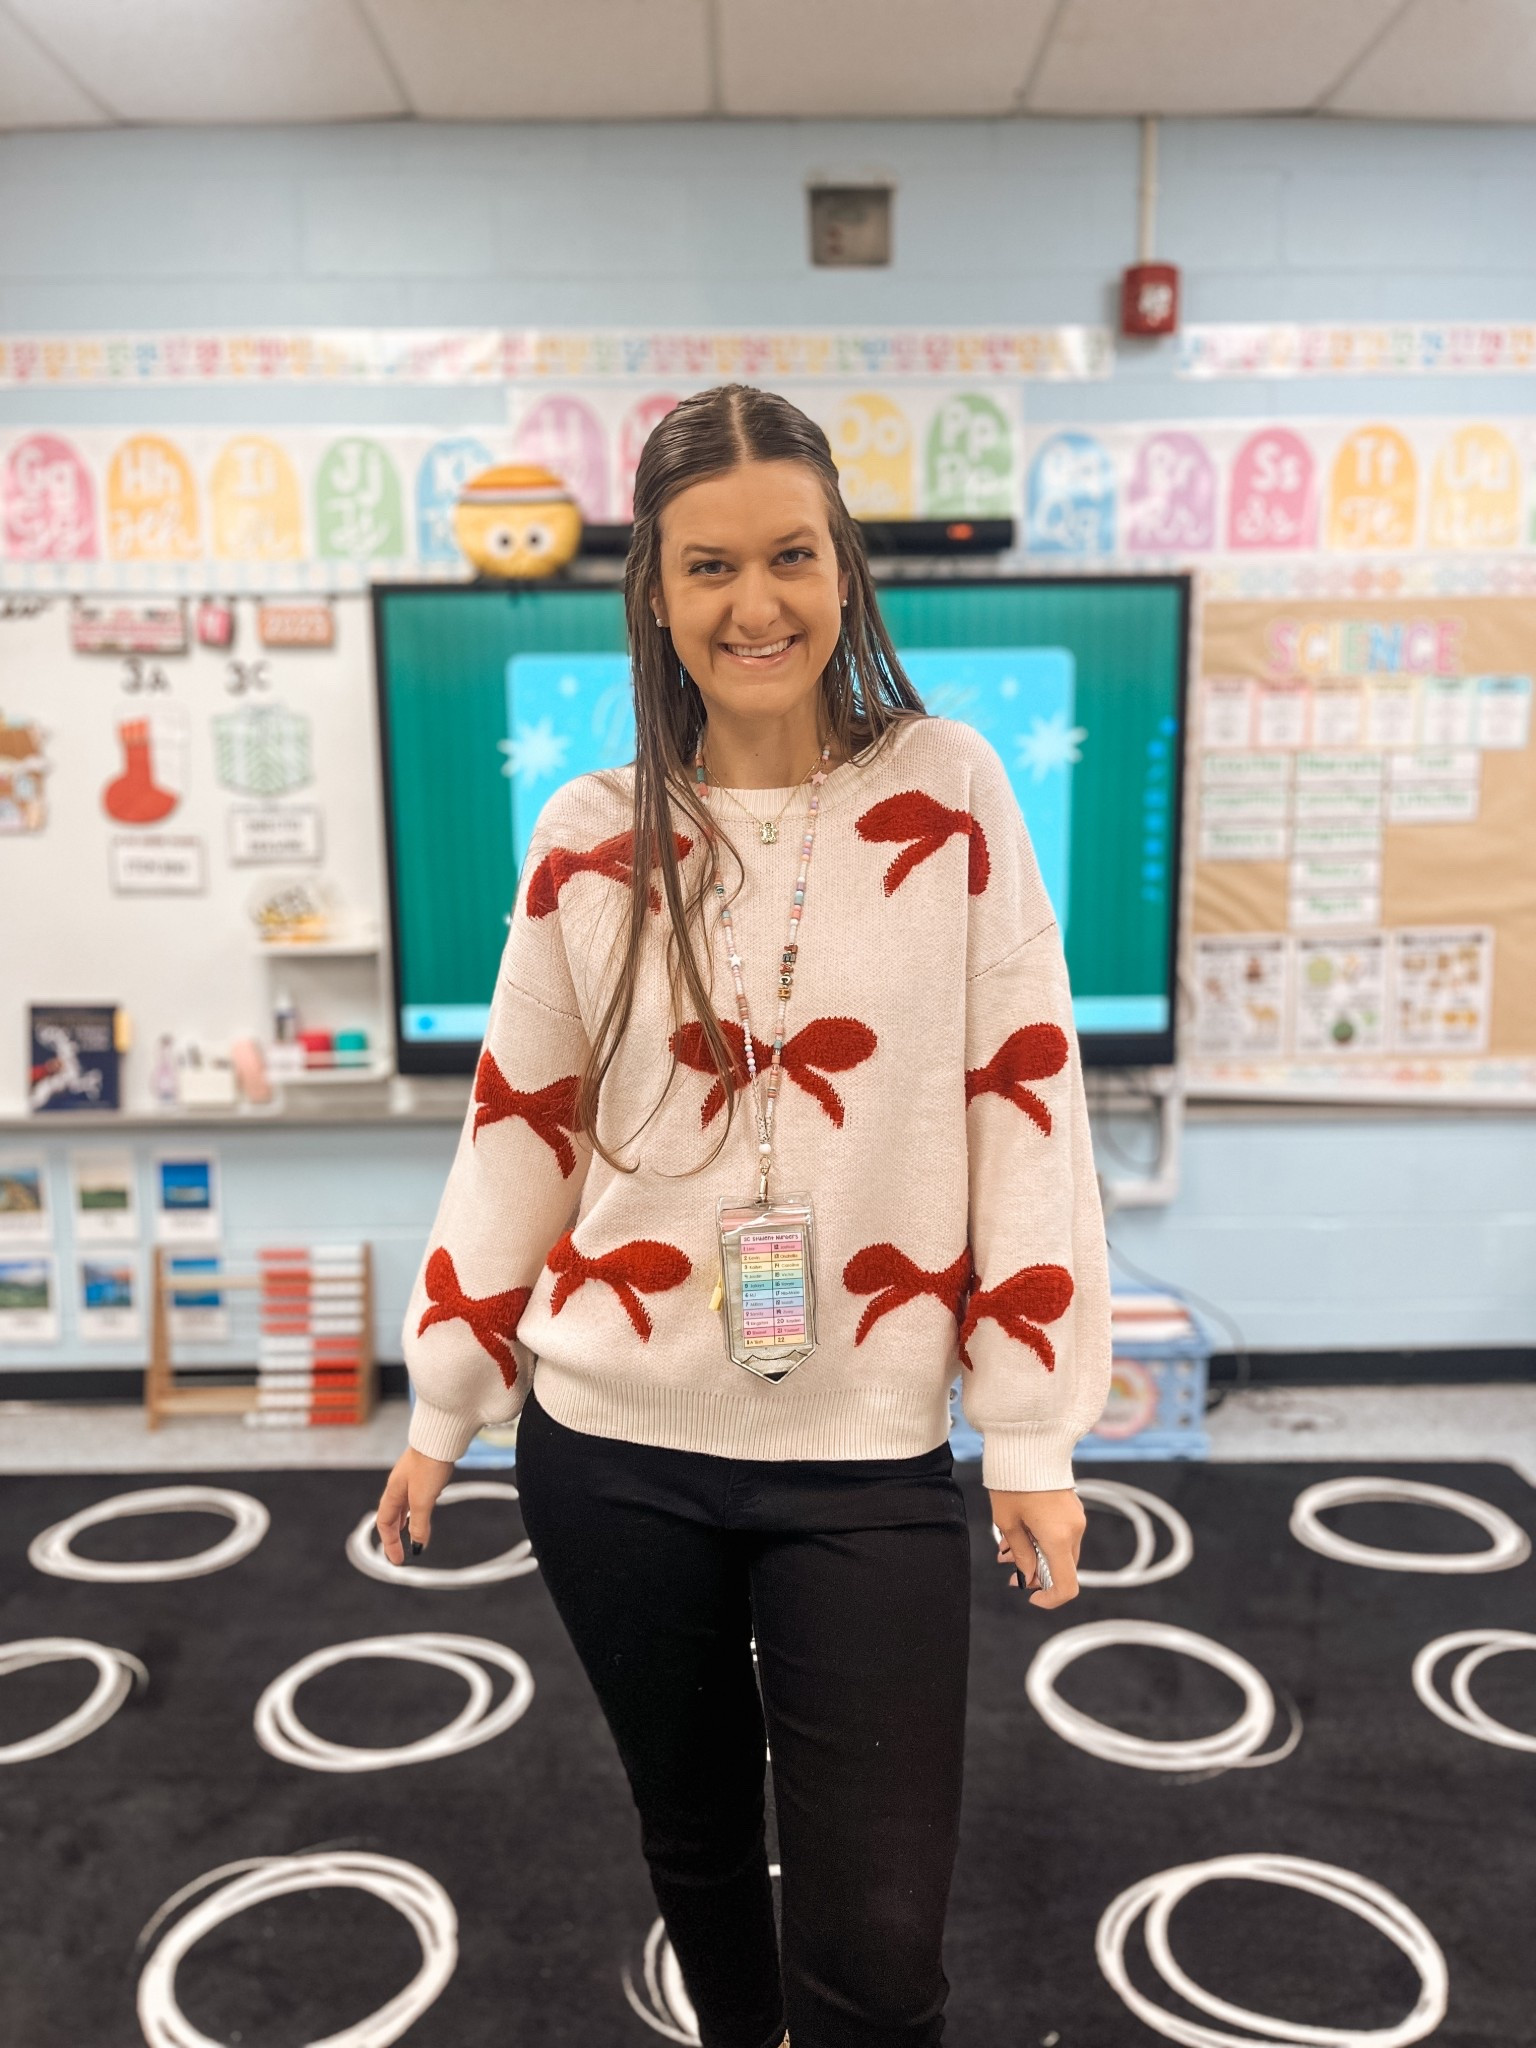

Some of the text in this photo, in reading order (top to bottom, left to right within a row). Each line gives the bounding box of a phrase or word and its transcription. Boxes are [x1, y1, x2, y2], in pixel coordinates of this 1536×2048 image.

[832, 405, 906, 459] Oo
[941, 402, 997, 463] Pp
[1269, 620, 1461, 675] SCIENCE
[225, 660, 272, 695] 3C
